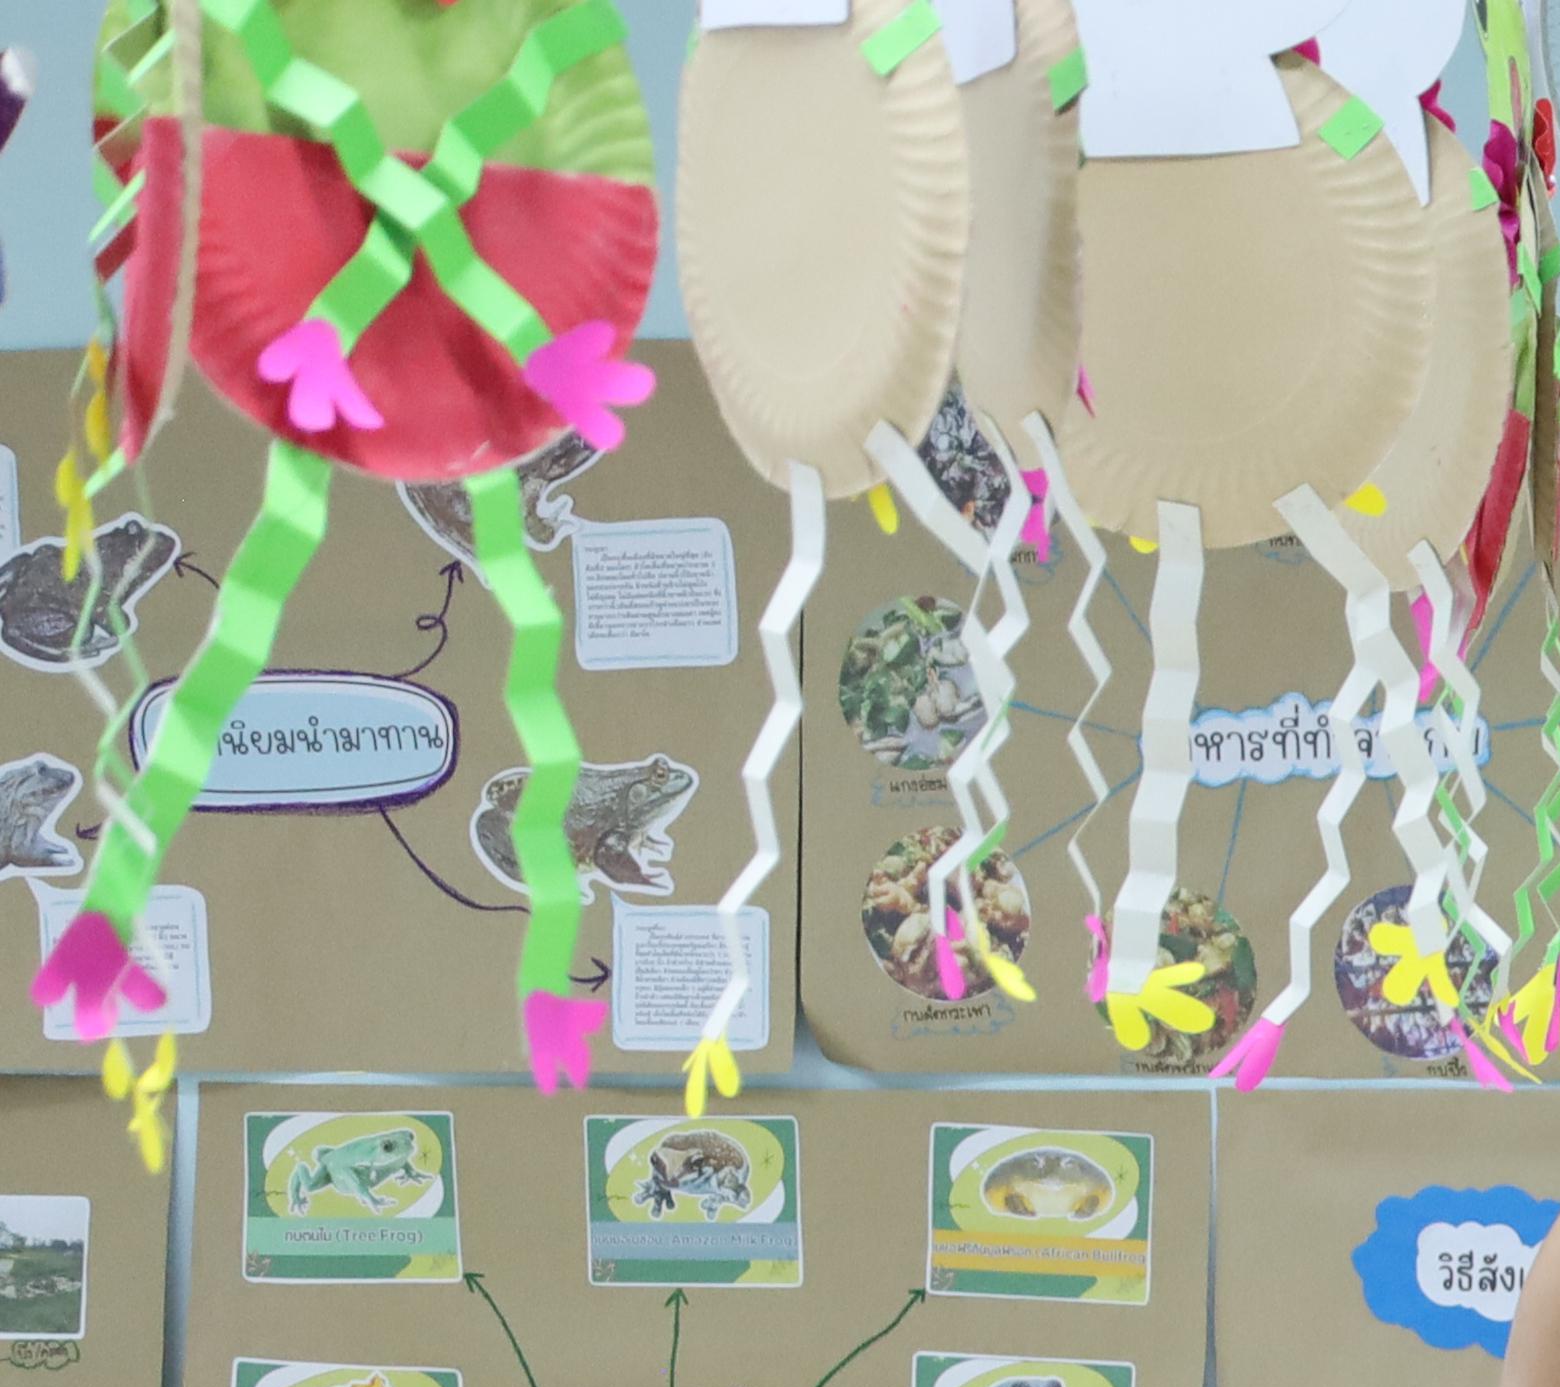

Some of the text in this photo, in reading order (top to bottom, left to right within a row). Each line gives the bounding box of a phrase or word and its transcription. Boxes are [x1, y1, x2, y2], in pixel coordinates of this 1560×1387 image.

[217, 715, 444, 757] นิยมนำมาทาน
